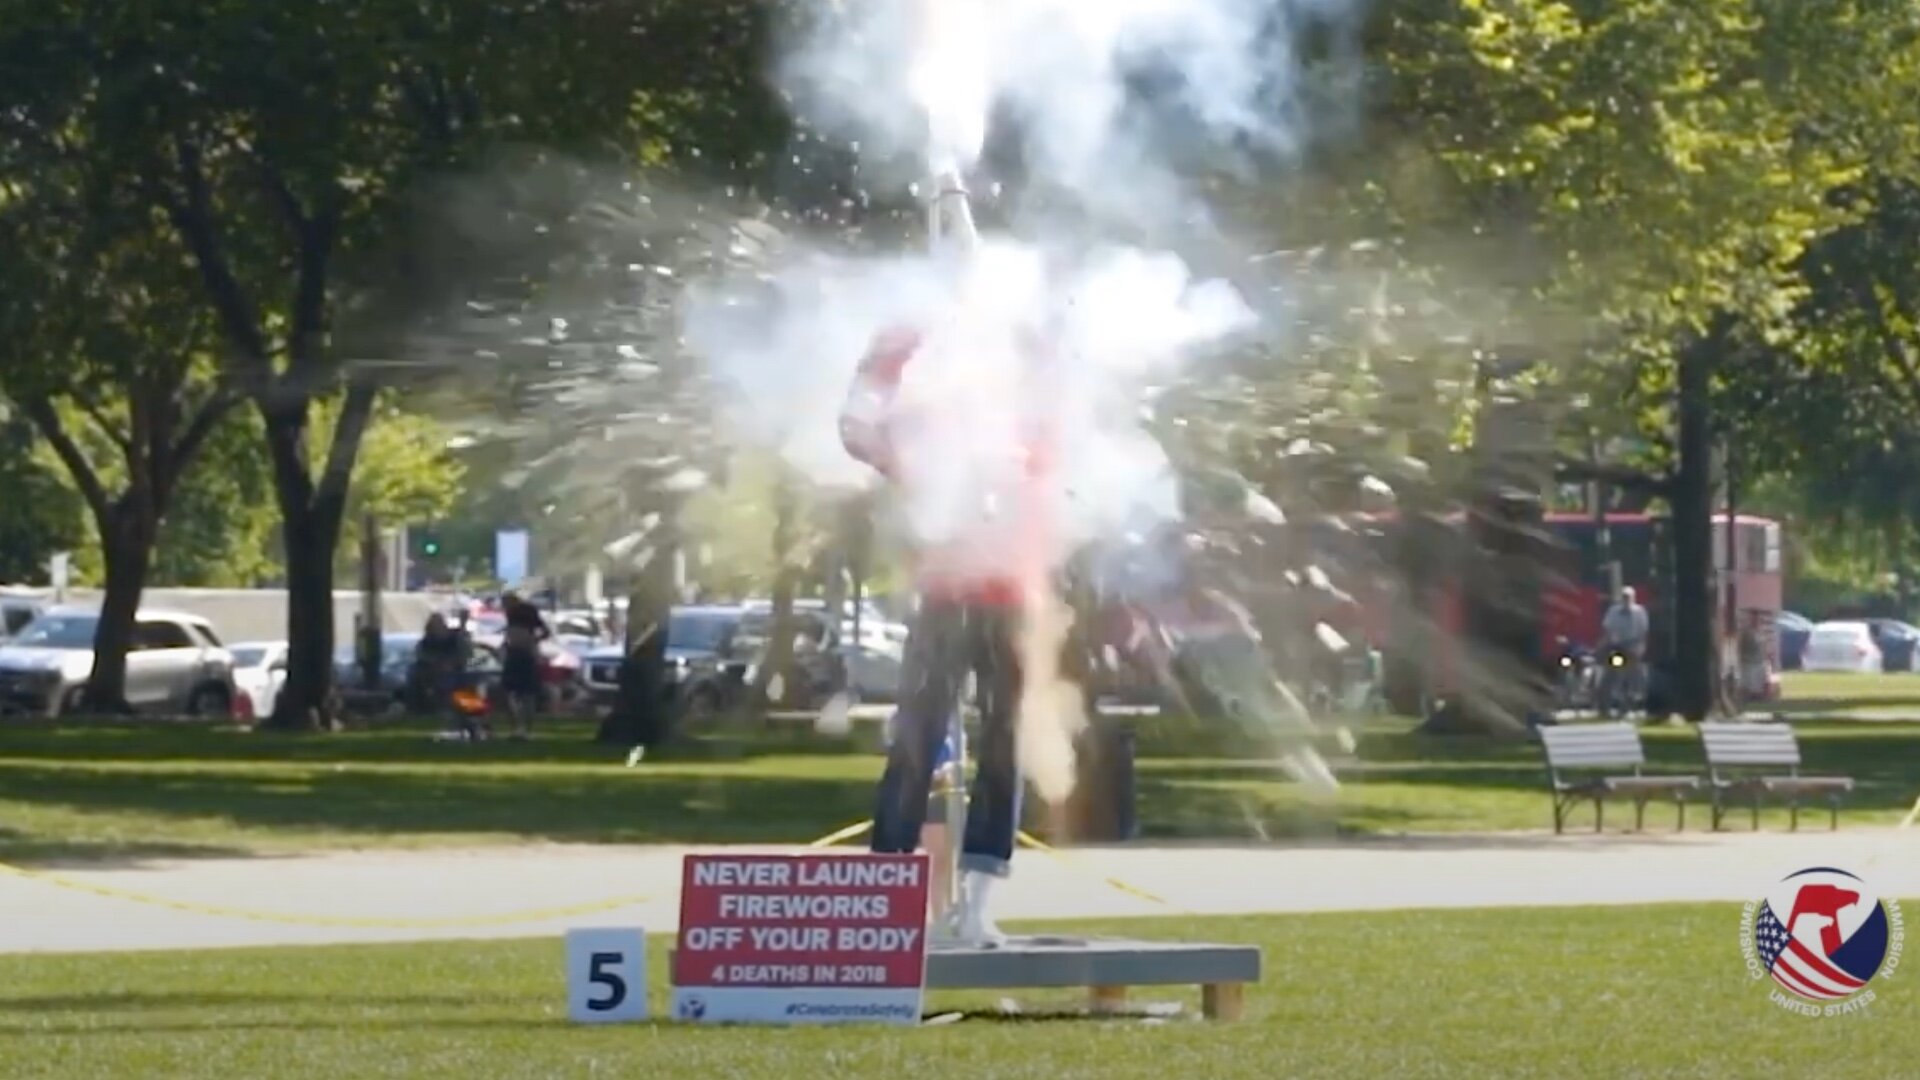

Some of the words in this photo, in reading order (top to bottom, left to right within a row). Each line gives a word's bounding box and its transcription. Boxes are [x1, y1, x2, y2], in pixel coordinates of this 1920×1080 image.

[694, 863, 791, 886] NEVER
[797, 863, 919, 886] LAUNCH
[719, 895, 889, 918] FIREWORKS
[686, 928, 742, 951] OFF
[750, 928, 830, 951] YOUR
[837, 928, 919, 951] BODY
[586, 952, 627, 1012] 5
[712, 965, 725, 982] 4
[730, 965, 809, 982] DEATHS
[814, 965, 836, 982] IN
[841, 965, 887, 982] 2018
